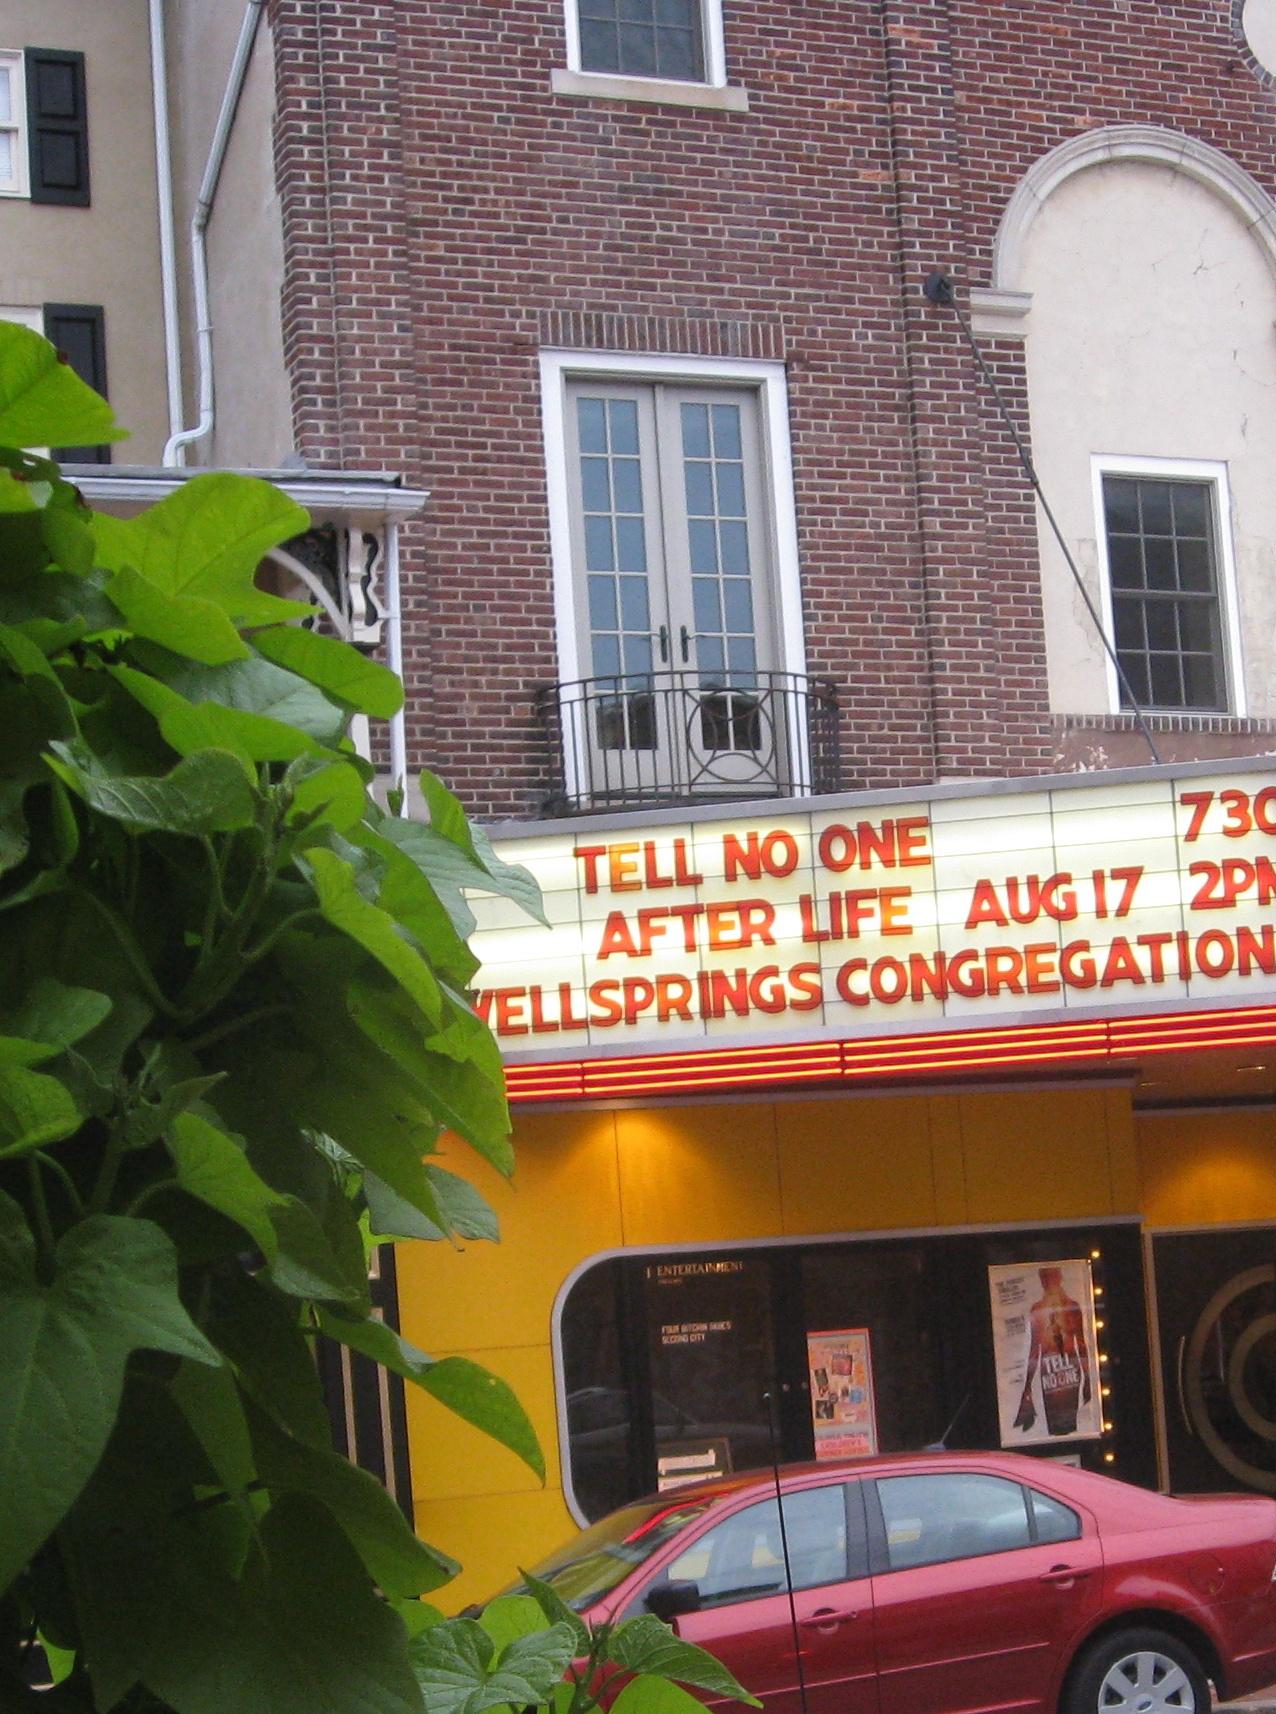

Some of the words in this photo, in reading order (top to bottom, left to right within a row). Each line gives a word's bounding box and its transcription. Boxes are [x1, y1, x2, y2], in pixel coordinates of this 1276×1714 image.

[573, 837, 703, 895] TELL
[722, 829, 800, 885] NO
[819, 816, 934, 875] ONE
[596, 898, 778, 961] AFTER
[800, 885, 914, 945] LIFE
[965, 872, 1080, 931] AUG
[1093, 866, 1145, 921] 17
[835, 925, 1276, 1005] CONGREGATION
[1043, 1353, 1074, 1375] TELL
